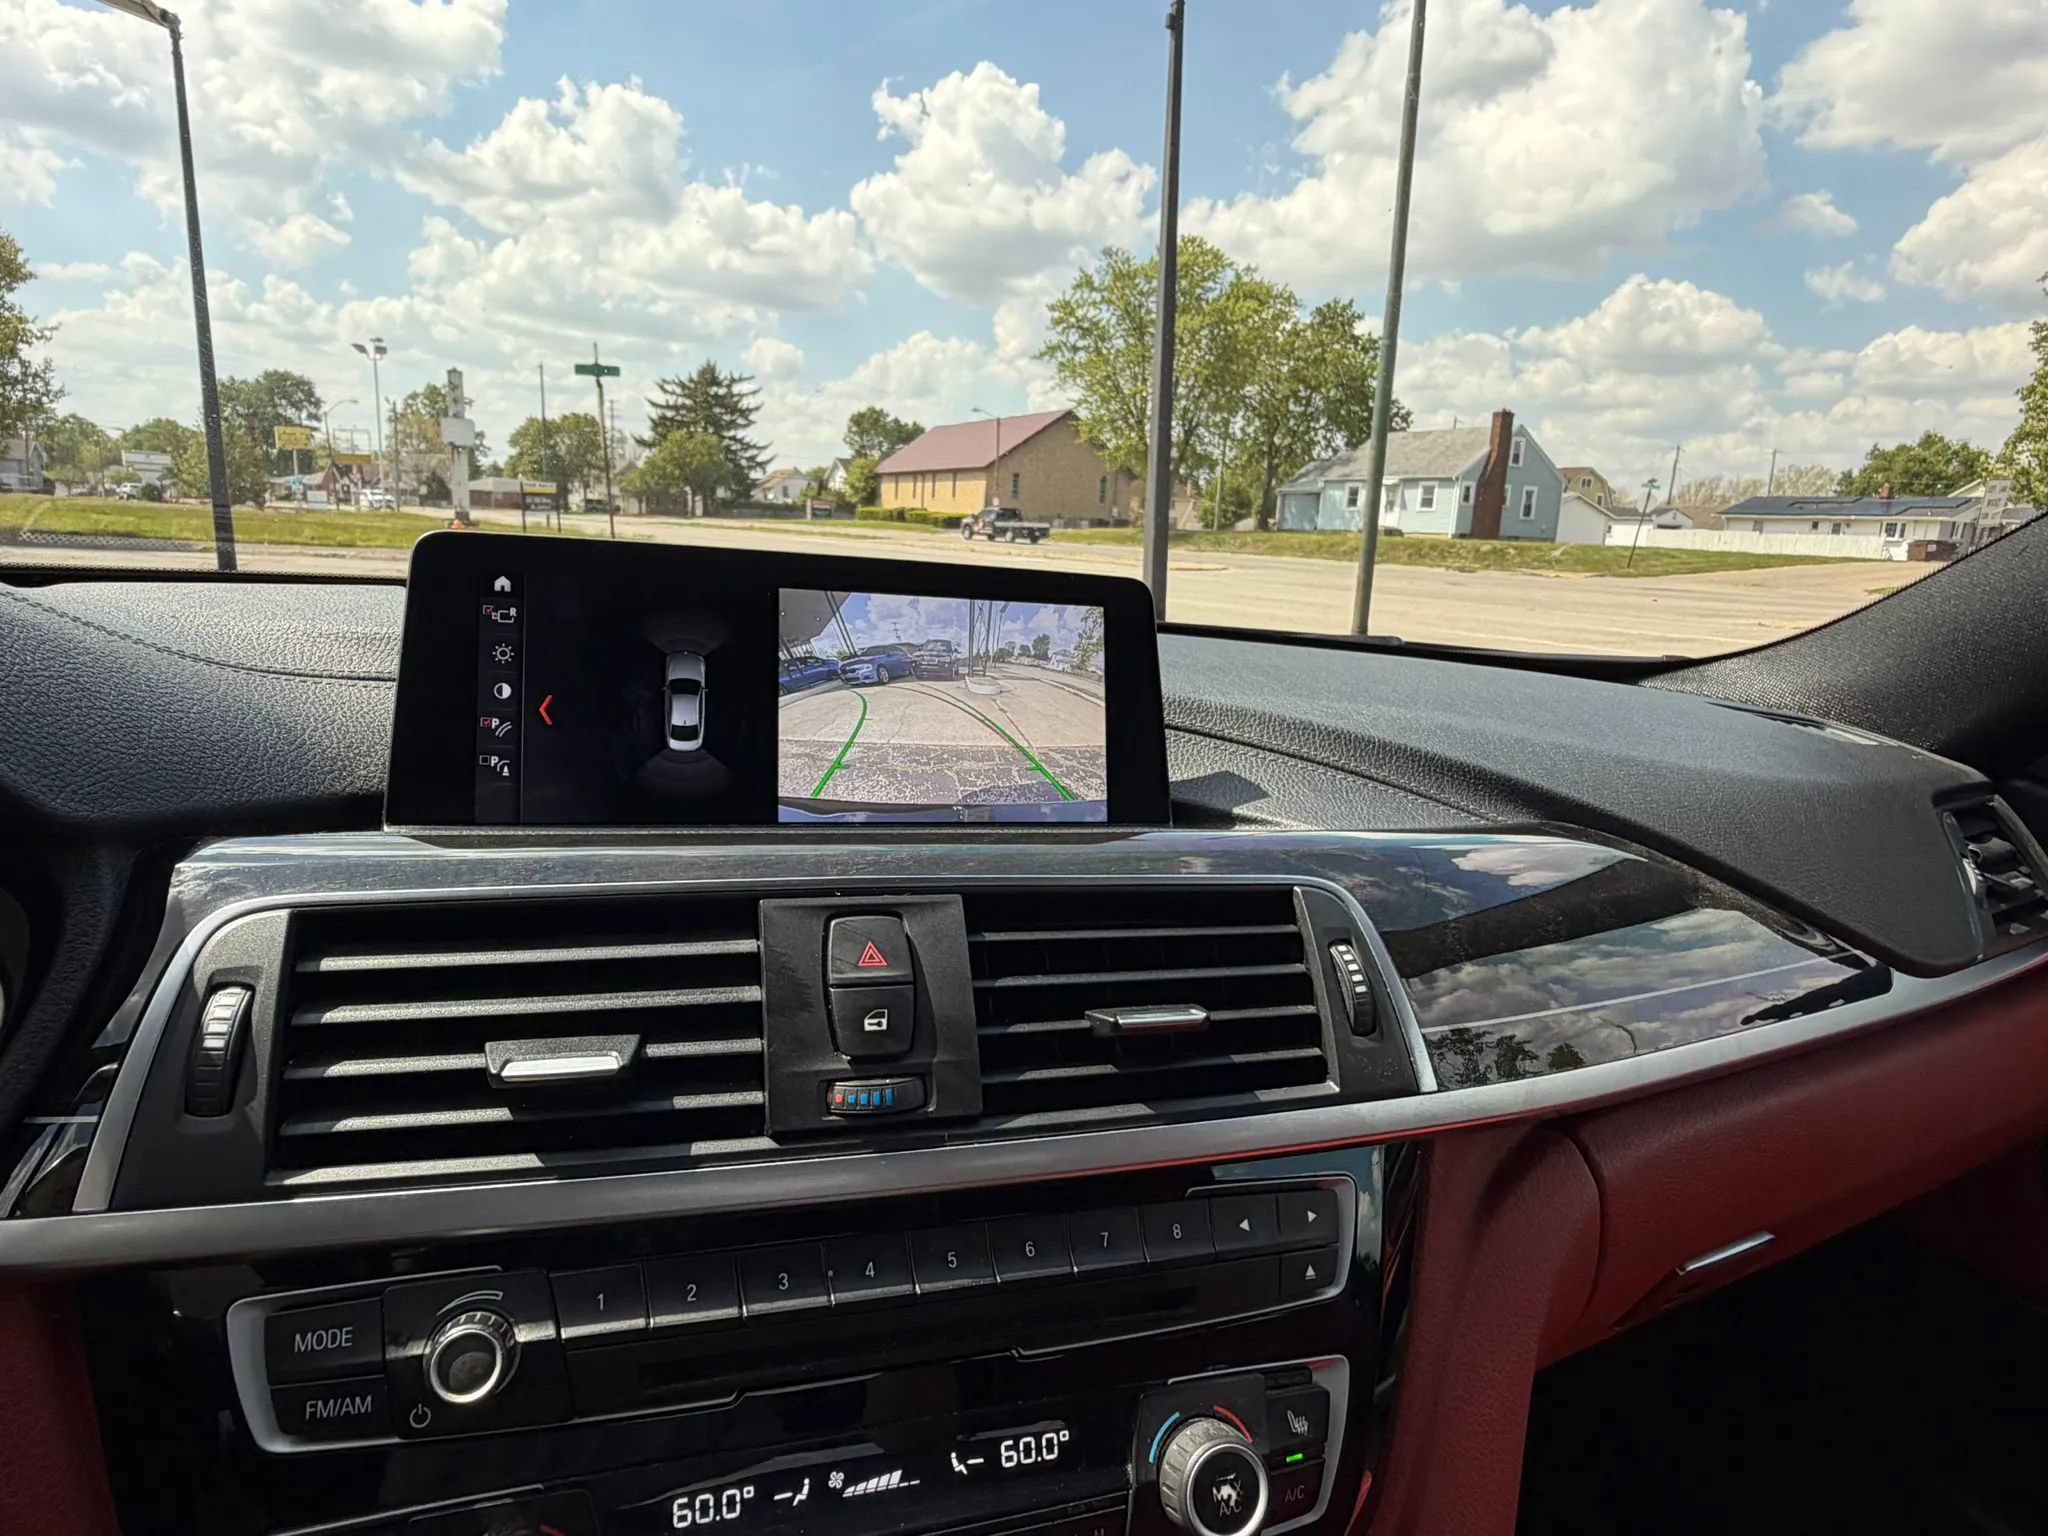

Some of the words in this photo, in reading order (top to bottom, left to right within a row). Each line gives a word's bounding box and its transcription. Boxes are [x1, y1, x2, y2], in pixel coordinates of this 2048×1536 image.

[510, 607, 517, 617] R
[491, 717, 499, 729] P
[490, 755, 498, 767] P
[1100, 1231, 1109, 1248] 7
[1172, 1223, 1182, 1239] 8
[1025, 1241, 1035, 1257] 6
[947, 1251, 957, 1268] 5
[865, 1261, 875, 1278] 4
[778, 1272, 789, 1290] 3
[687, 1283, 697, 1302] 2
[596, 1293, 604, 1312] 1
[294, 1326, 353, 1353] MODE
[305, 1394, 372, 1420] FM/AM
[1000, 1430, 1070, 1468] 60.0°
[1284, 1484, 1305, 1503] A/C
[672, 1485, 755, 1529] 60.0°
